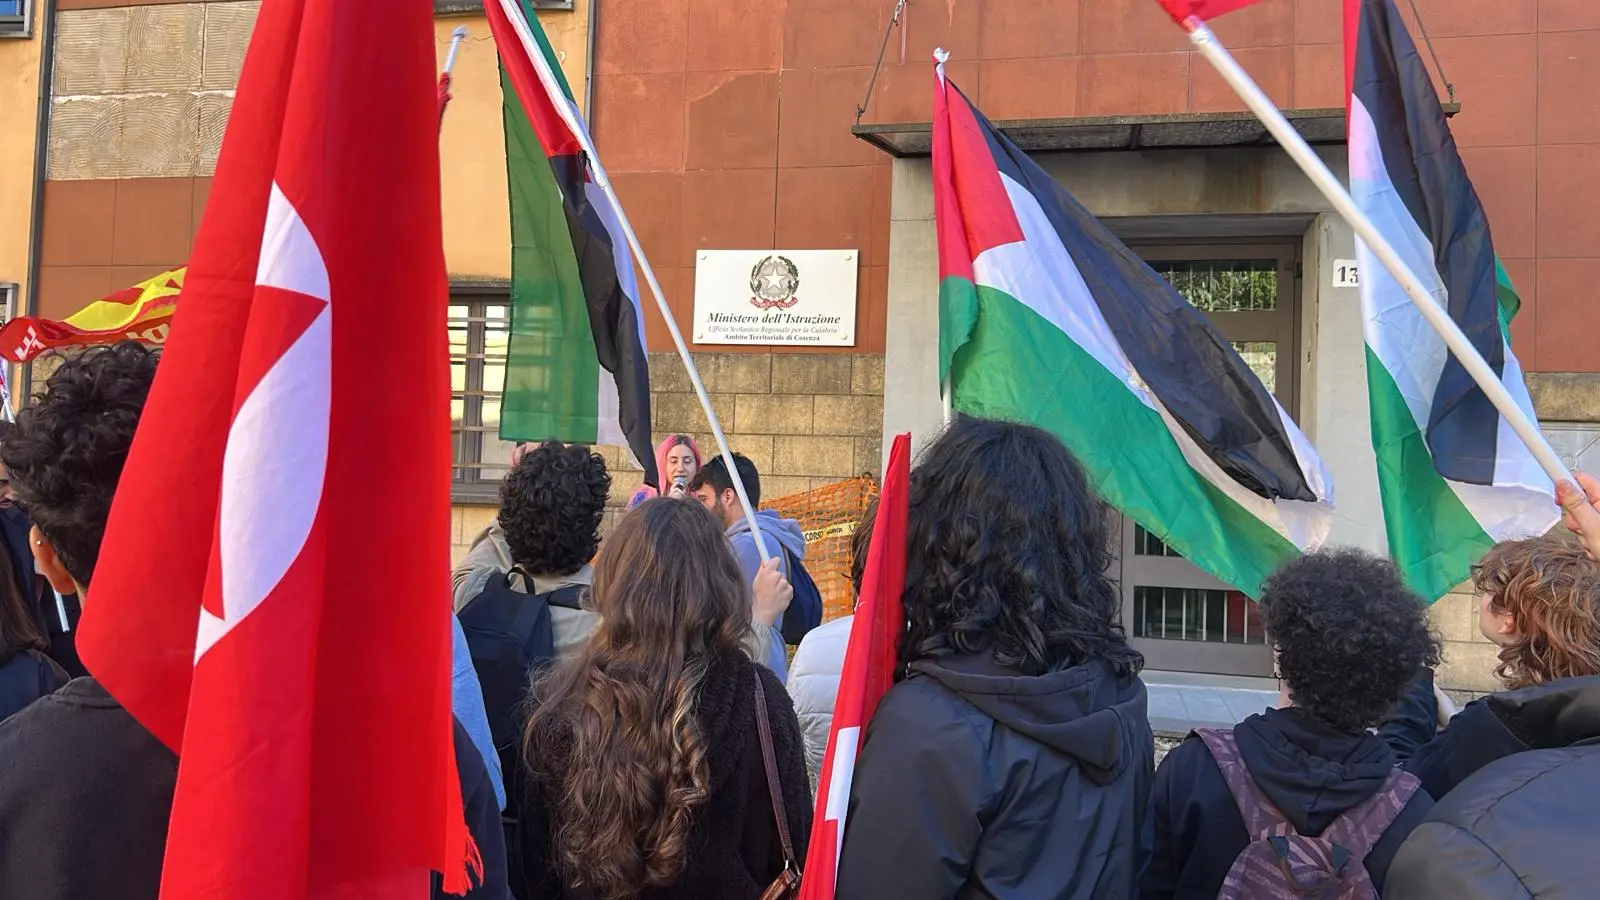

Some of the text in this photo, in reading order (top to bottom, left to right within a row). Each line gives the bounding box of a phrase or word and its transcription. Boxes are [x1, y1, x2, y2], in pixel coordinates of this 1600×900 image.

[1338, 266, 1358, 284] 13
[706, 313, 759, 323] Ministero
[760, 326, 790, 334] Regionale
[791, 327, 801, 335] per
